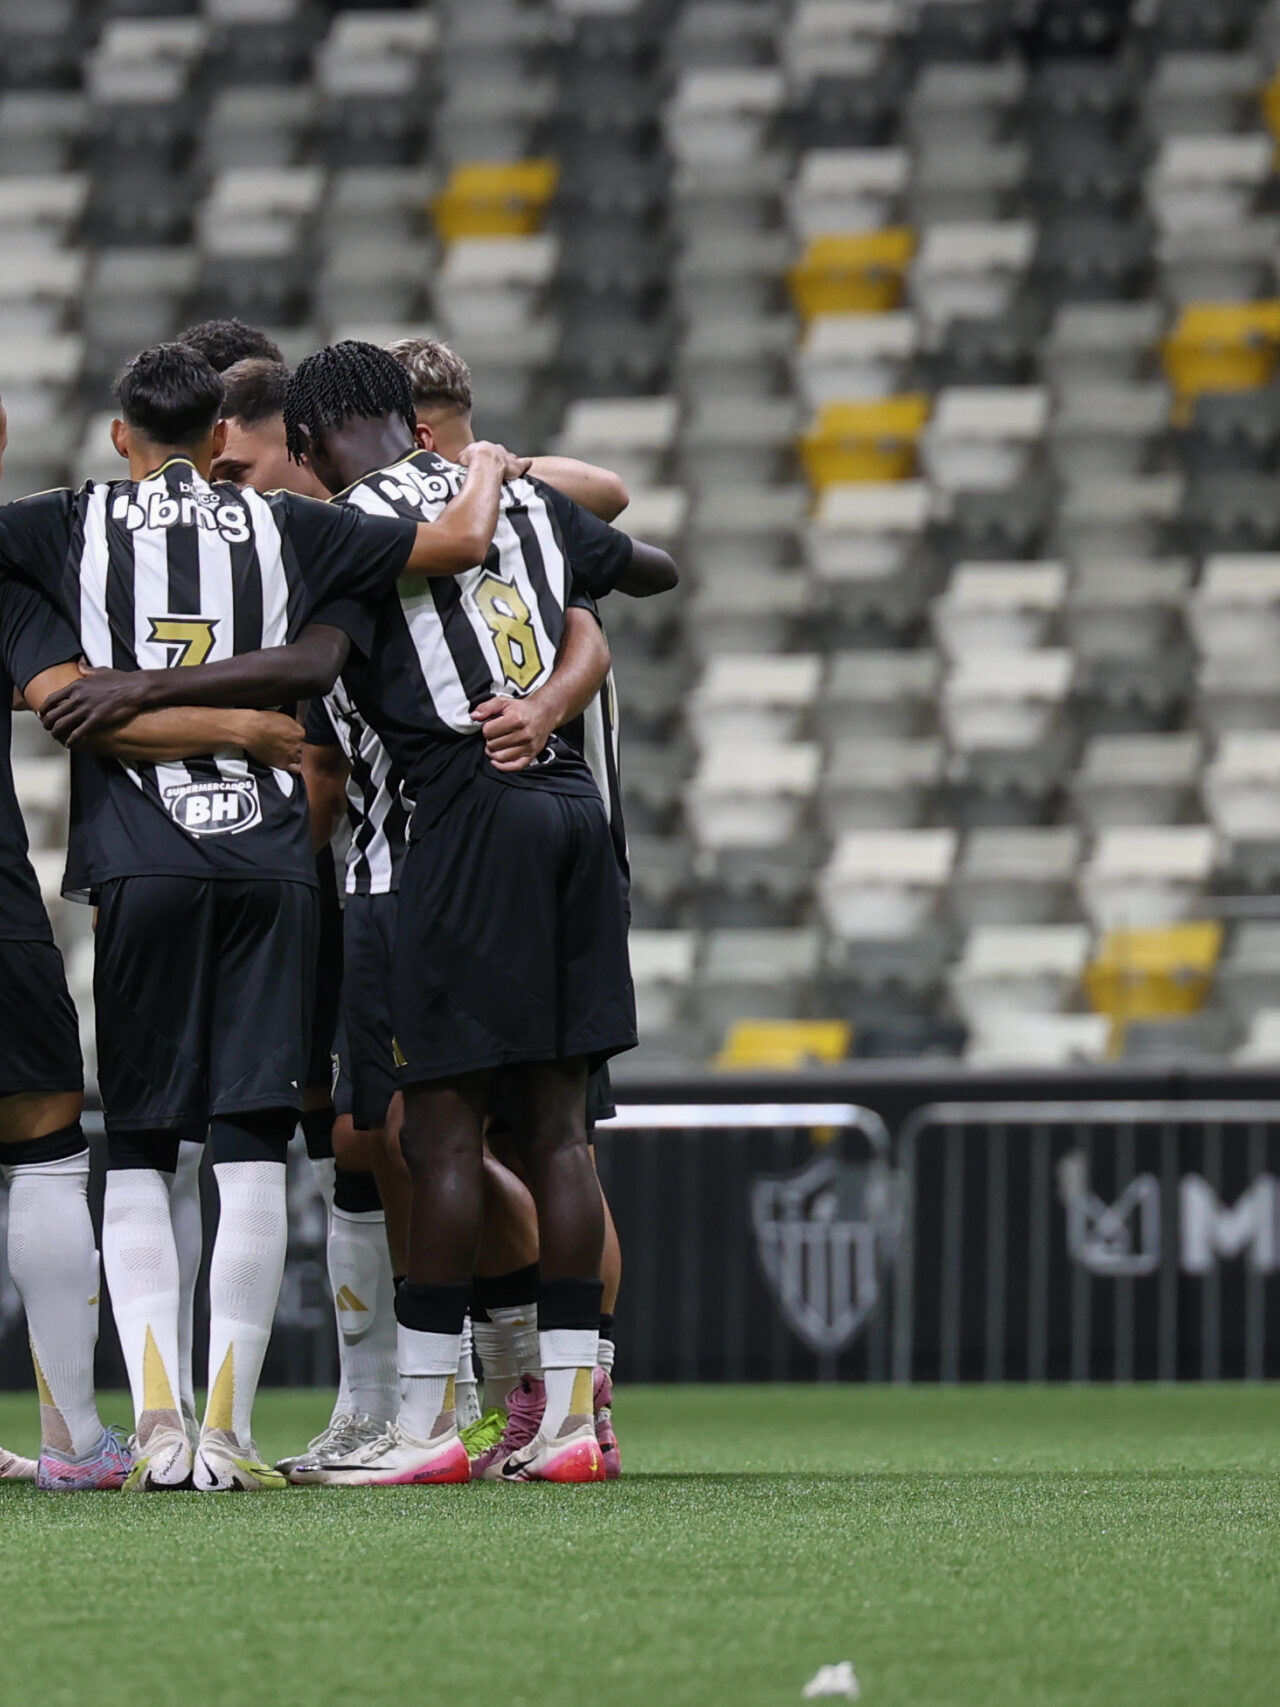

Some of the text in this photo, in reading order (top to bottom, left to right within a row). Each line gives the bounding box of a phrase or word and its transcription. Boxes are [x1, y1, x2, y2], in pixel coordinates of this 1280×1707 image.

[147, 492, 251, 543] bmg
[145, 616, 222, 668] 7
[471, 572, 545, 692] 8
[166, 781, 252, 797] SUPERMERCADOS
[185, 793, 239, 826] BH
